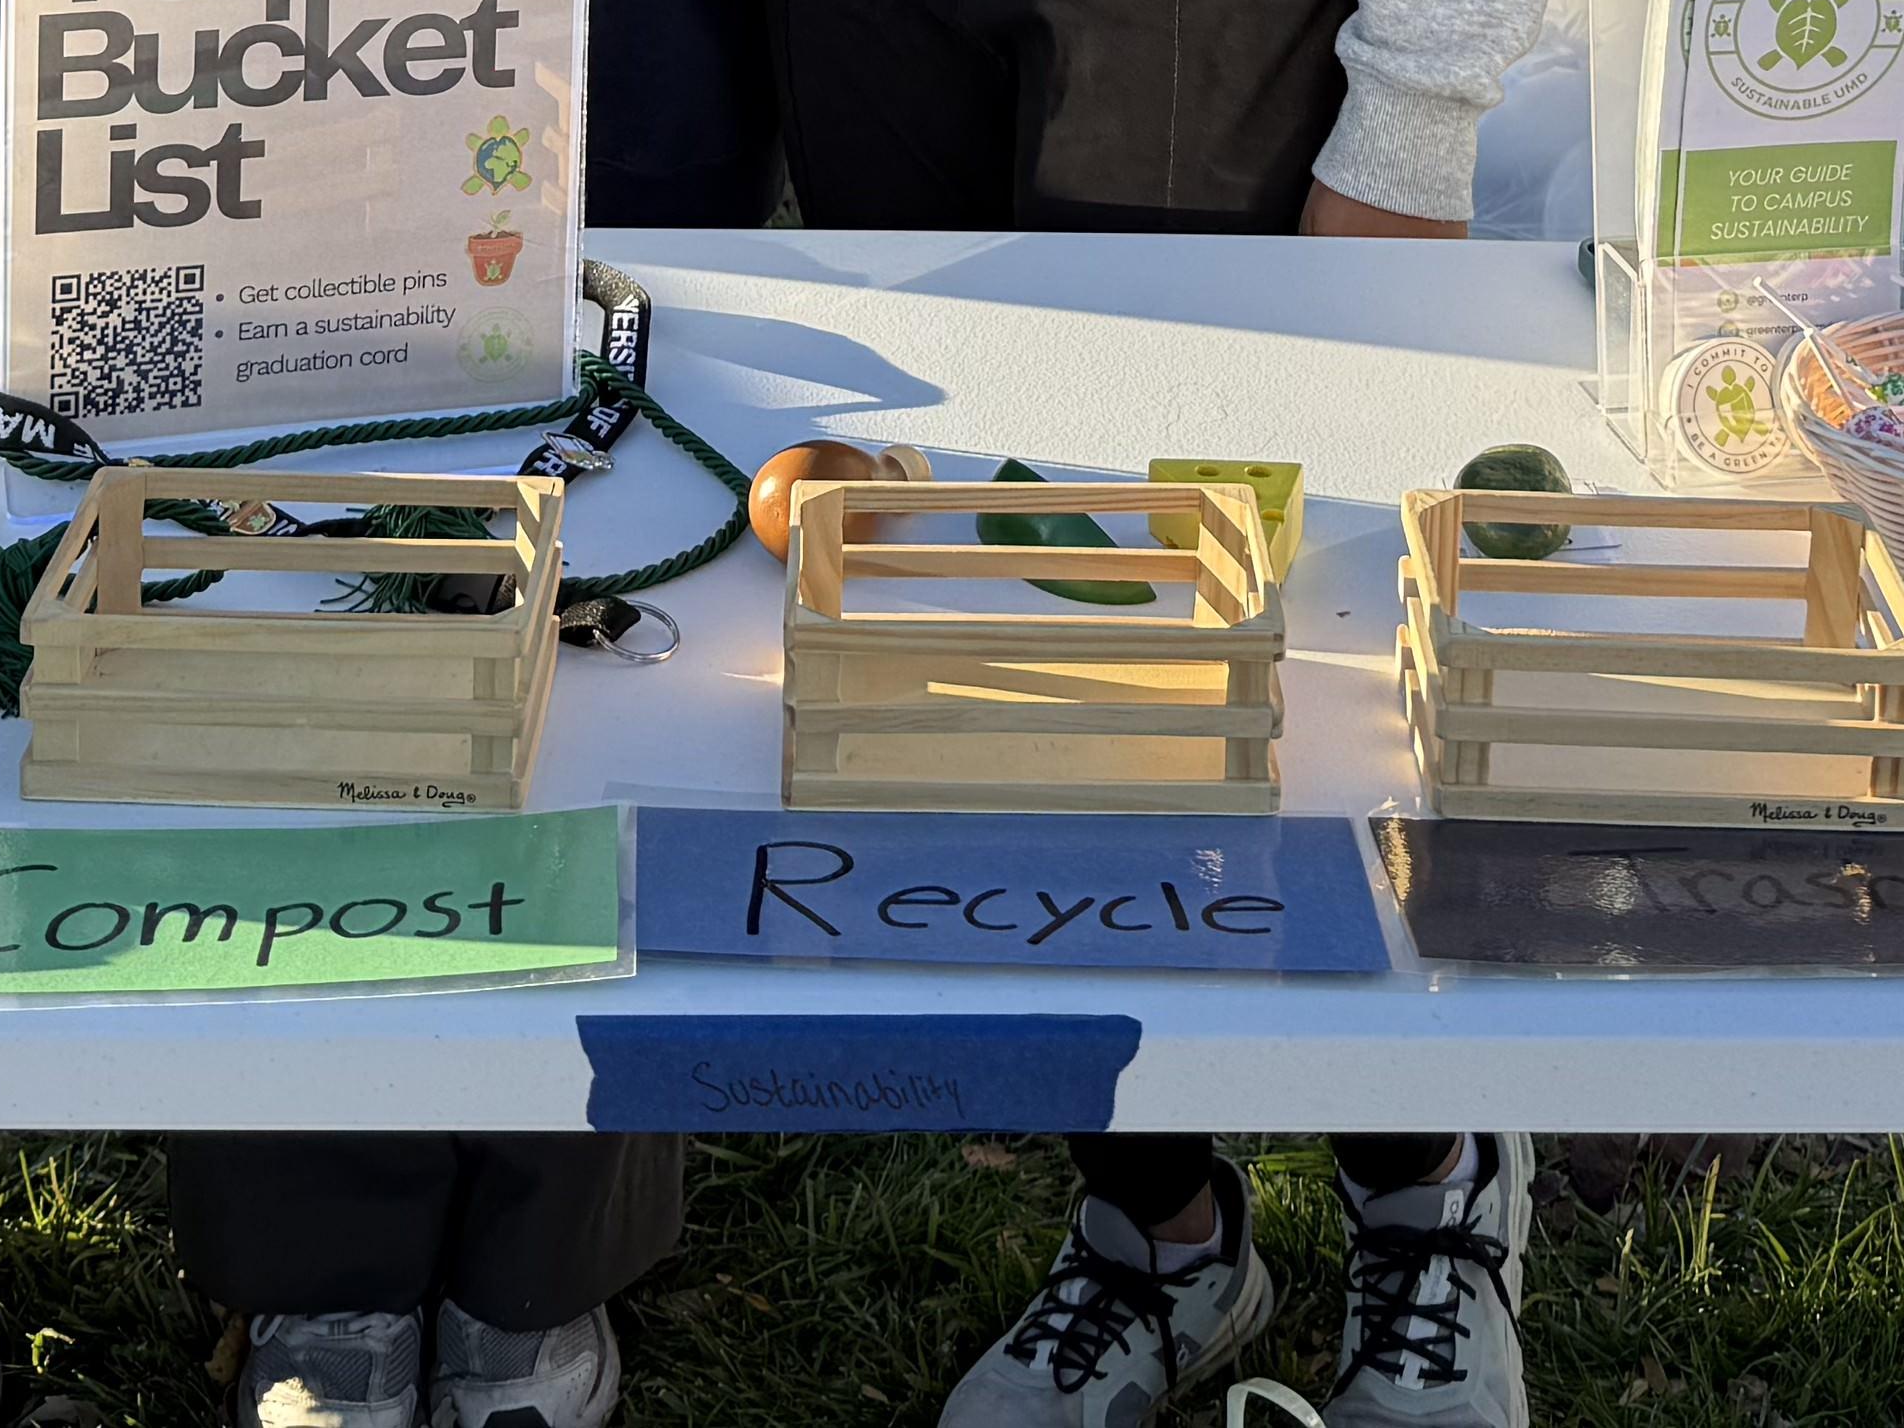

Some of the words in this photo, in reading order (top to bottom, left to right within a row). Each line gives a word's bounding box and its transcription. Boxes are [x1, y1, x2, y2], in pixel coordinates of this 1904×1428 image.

[1732, 77, 1831, 110] SUSTAINABLE
[1835, 73, 1868, 97] UMD
[35, 122, 265, 235] List
[1728, 167, 1783, 186] YOUR
[1790, 164, 1853, 183] GUIDE
[1731, 195, 1757, 212] TO
[1763, 190, 1853, 210] CAMPUS
[1711, 215, 1869, 240] SUSTAINABILITY
[239, 286, 278, 304] Get
[285, 273, 396, 300] collectible
[403, 271, 447, 296] pins
[238, 321, 288, 341] Earn
[296, 321, 309, 336] a
[315, 305, 456, 334] sustainability
[236, 349, 352, 382] graduation
[360, 343, 409, 365] cord
[1694, 349, 1746, 375] COMMIT
[1754, 357, 1768, 372] TO
[587, 406, 620, 439] OF
[337, 782, 406, 803] Melissa
[1750, 803, 1818, 823] Melissa
[746, 841, 1285, 946] Recycle
[692, 1062, 966, 1120] Sustainability
